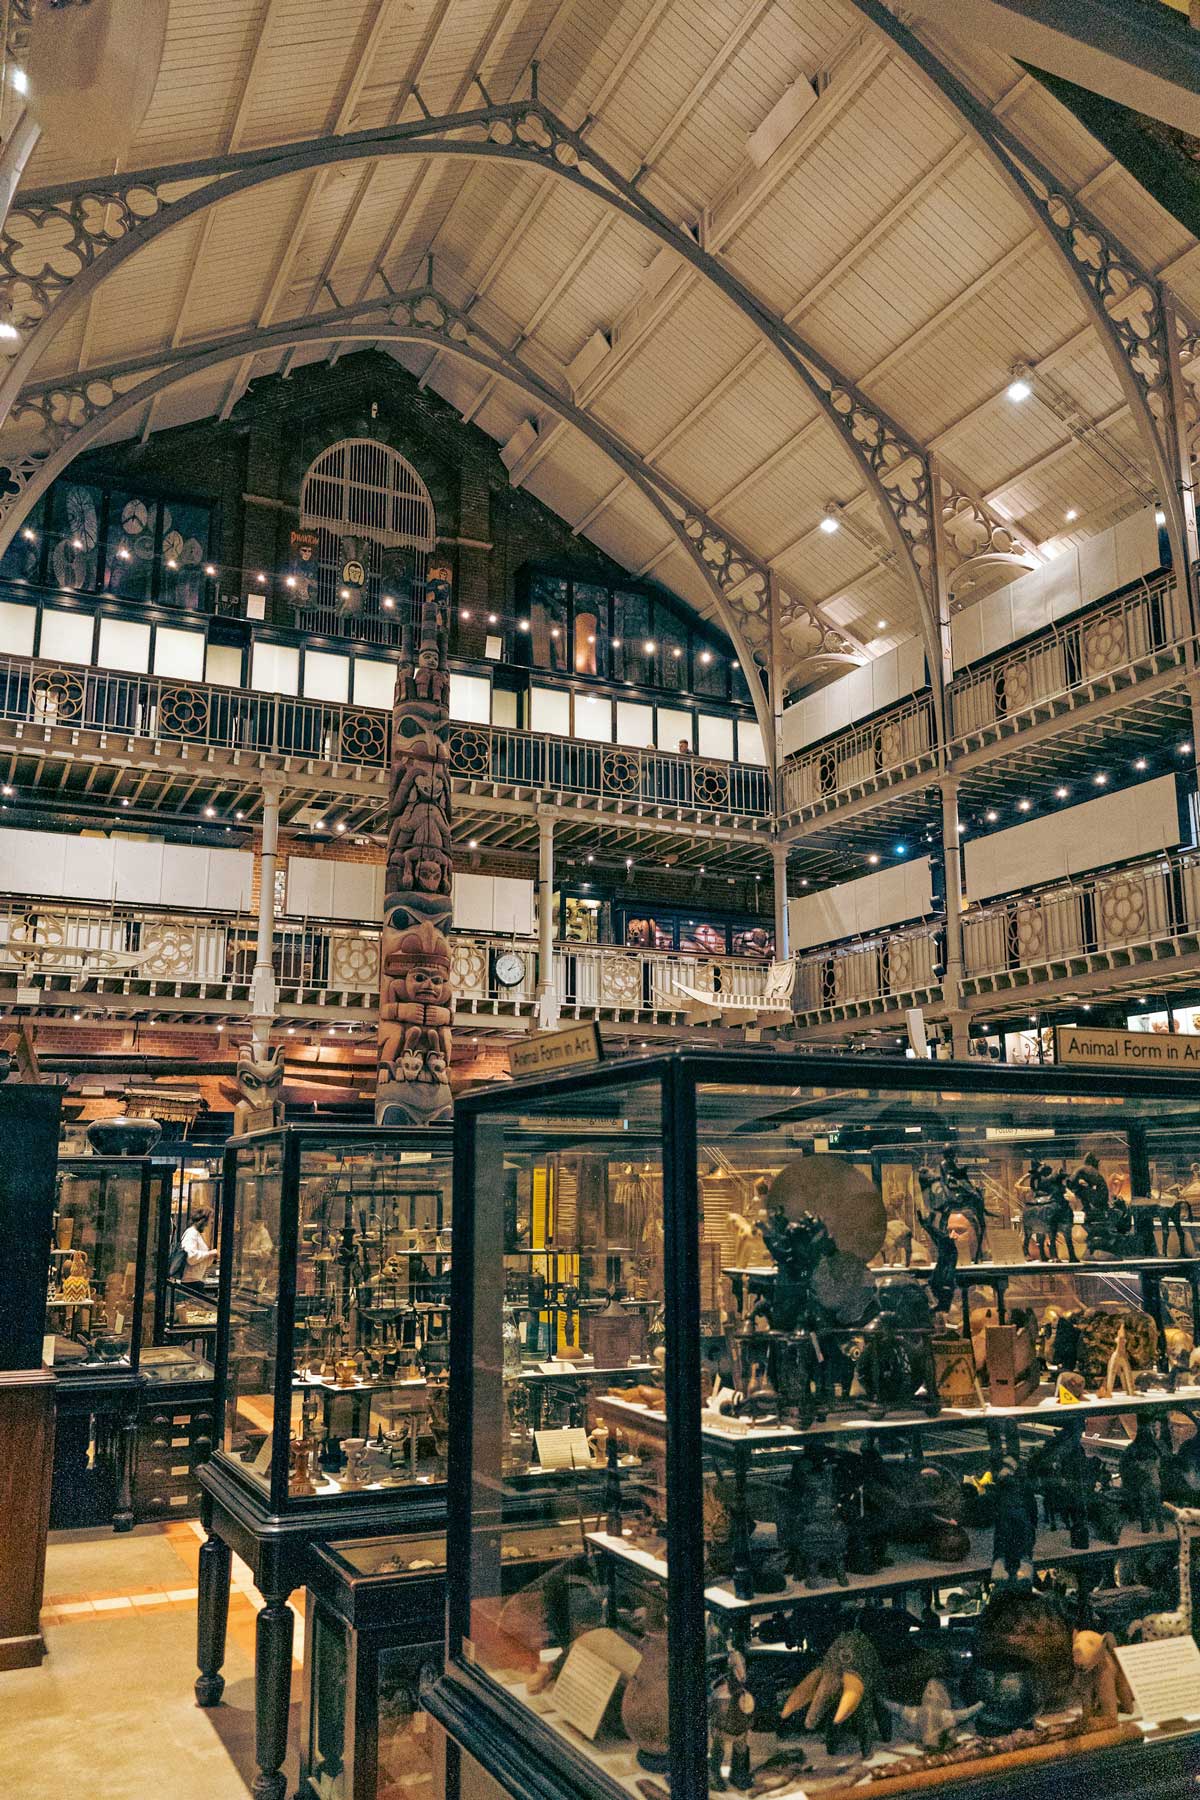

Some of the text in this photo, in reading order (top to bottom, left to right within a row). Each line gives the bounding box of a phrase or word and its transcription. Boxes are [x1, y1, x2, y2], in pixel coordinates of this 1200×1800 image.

[513, 1037, 591, 1066] Animal Form in Art
[1068, 1037, 1200, 1061] Animal Form in Ar
